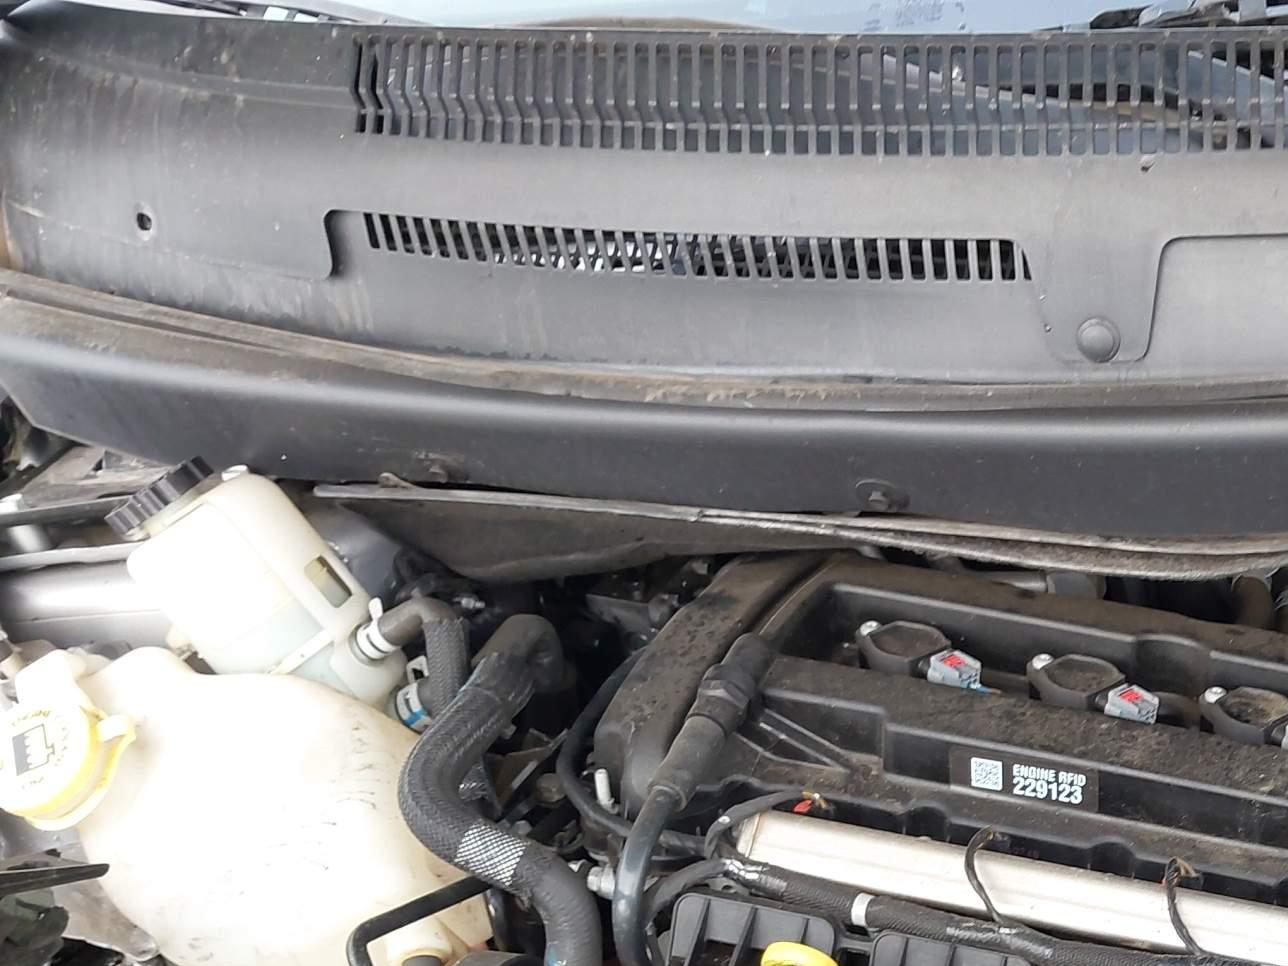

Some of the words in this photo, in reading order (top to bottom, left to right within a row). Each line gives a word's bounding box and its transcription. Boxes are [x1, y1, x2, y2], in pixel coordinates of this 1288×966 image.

[1012, 763, 1057, 782] ENGINE
[1058, 770, 1087, 787] RFID
[1012, 776, 1083, 805] 229123
